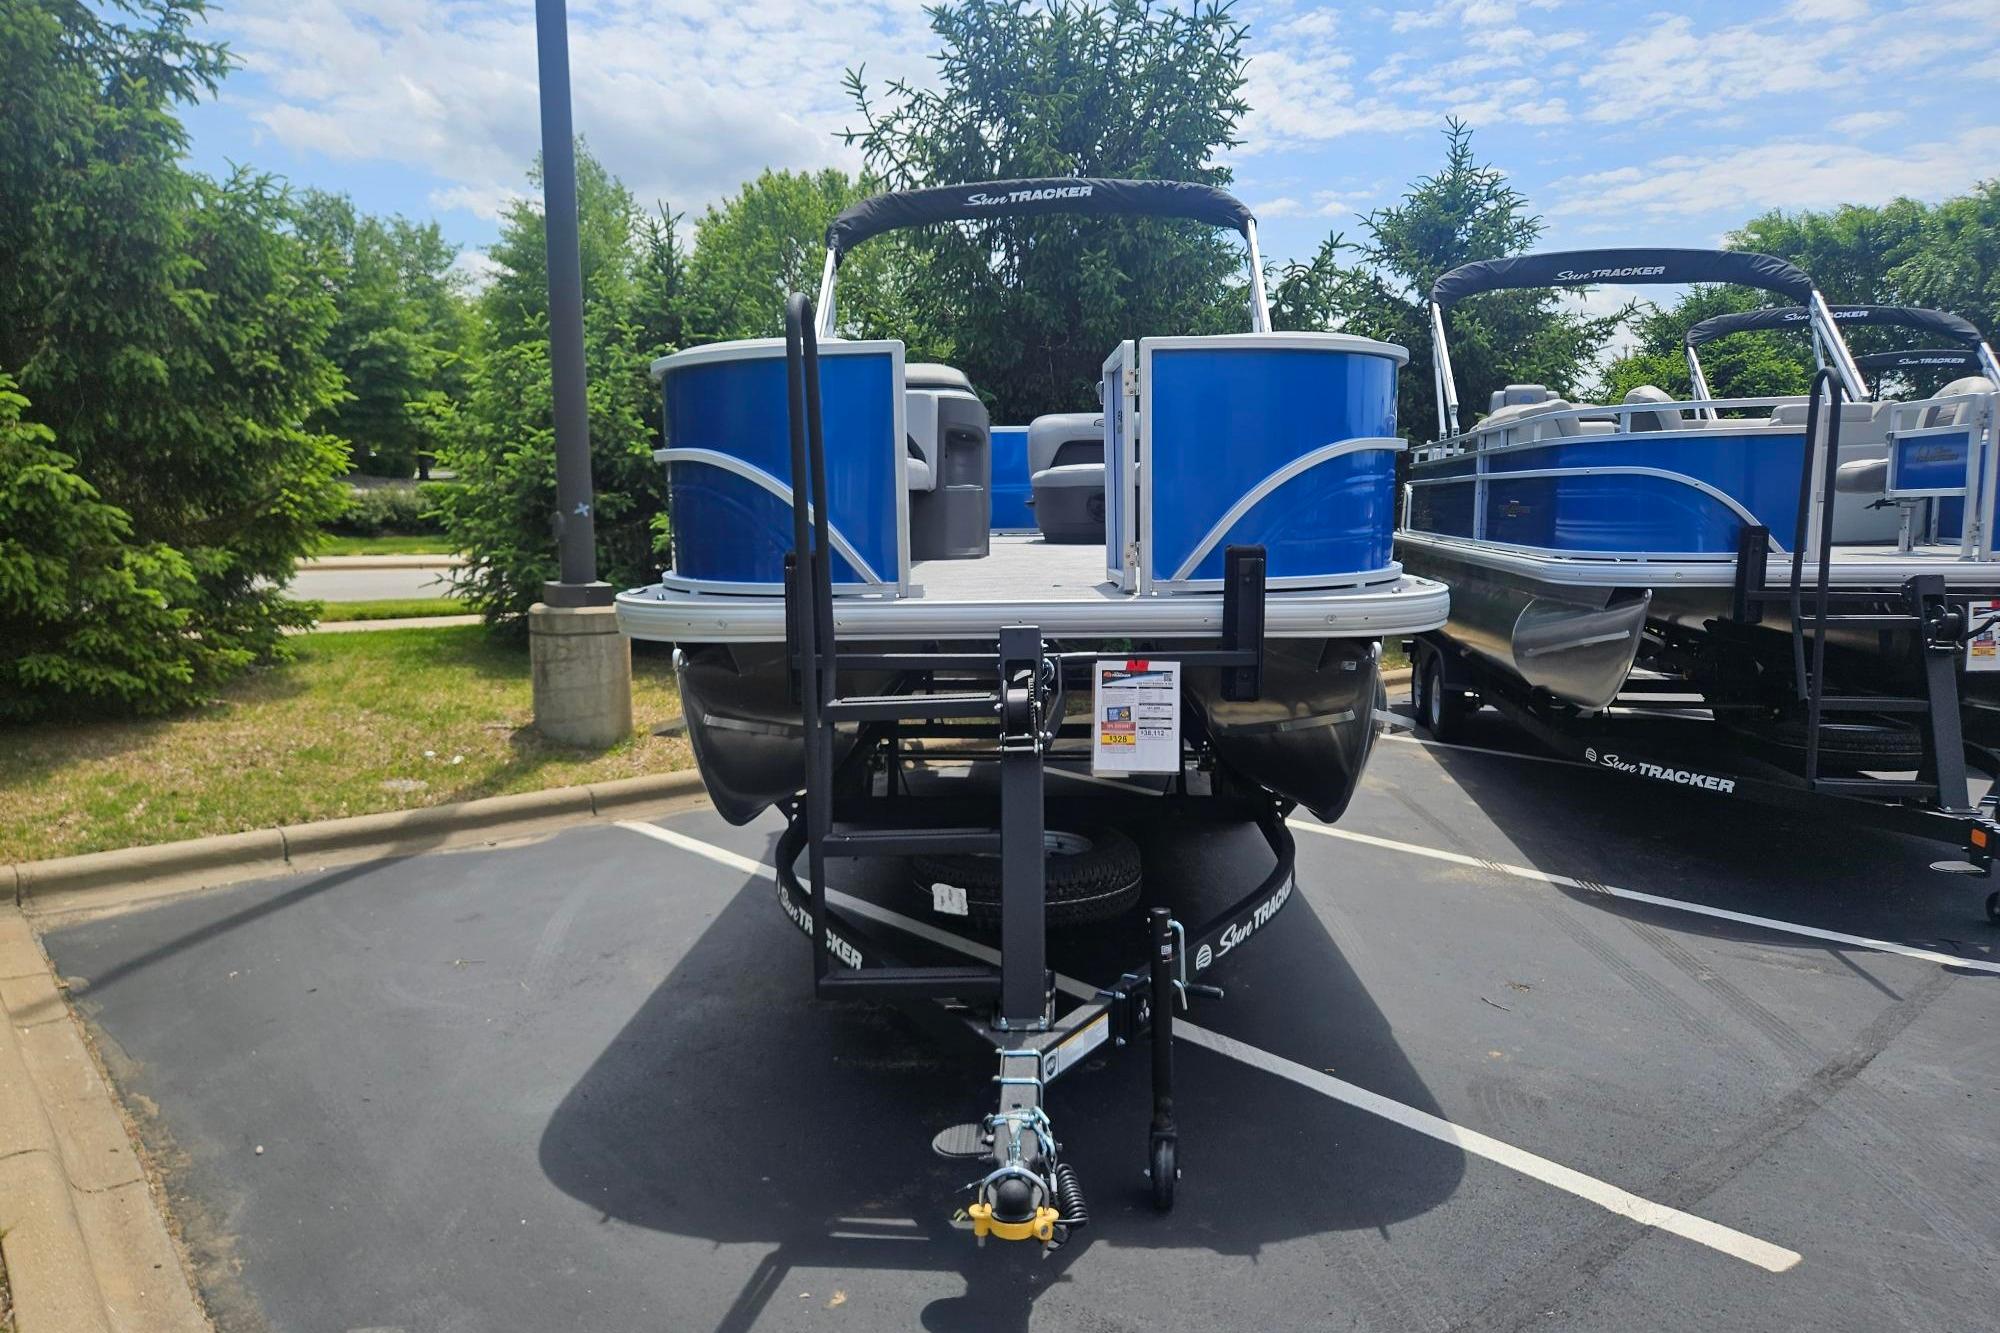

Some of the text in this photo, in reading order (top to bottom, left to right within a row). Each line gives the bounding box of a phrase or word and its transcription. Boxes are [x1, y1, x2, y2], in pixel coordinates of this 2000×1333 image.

[963, 186, 1093, 206] Sun TRACKER
[1553, 266, 1666, 280] Sun TRACKER
[1818, 310, 1869, 319] CKER
[1600, 754, 1736, 793] Sun TRACKER
[799, 905, 863, 970] TRKER
[1215, 920, 1253, 958] Sun
